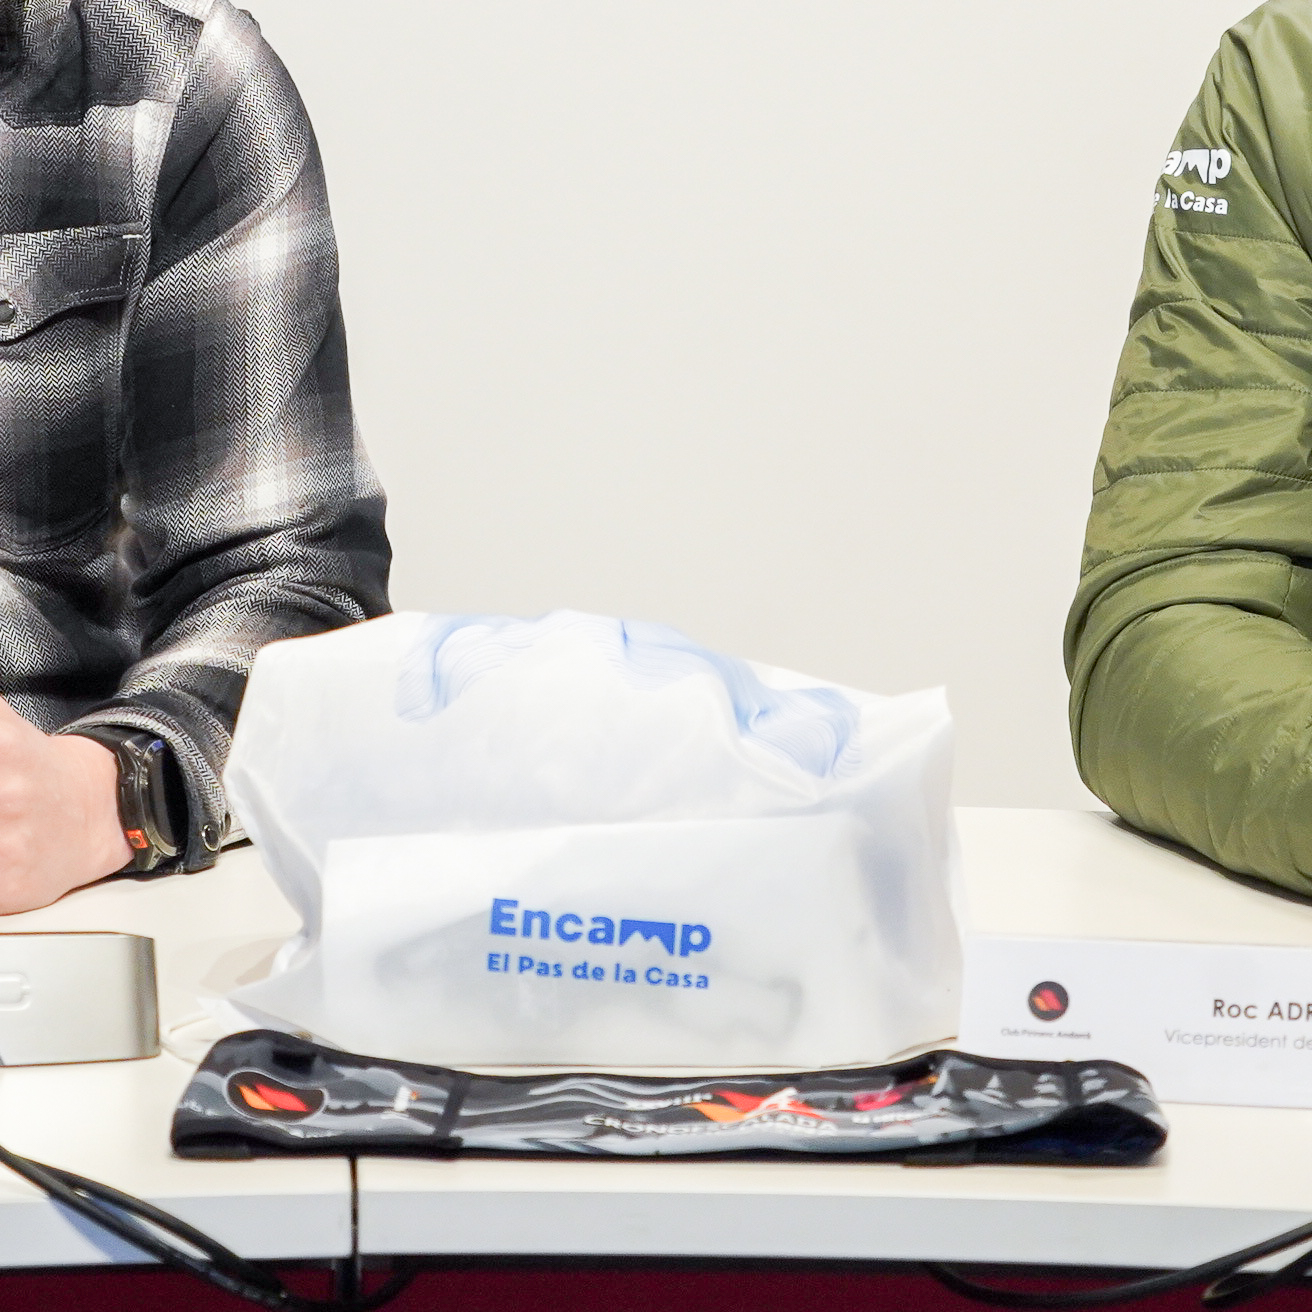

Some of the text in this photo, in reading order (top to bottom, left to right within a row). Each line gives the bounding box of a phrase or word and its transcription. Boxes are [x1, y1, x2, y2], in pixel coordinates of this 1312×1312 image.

[1180, 191, 1228, 214] Casa
[489, 898, 712, 957] Encamp
[487, 952, 709, 990] El Pas de la Casa
[1213, 999, 1258, 1019] Roc
[1164, 1028, 1288, 1049] Vicepresident
